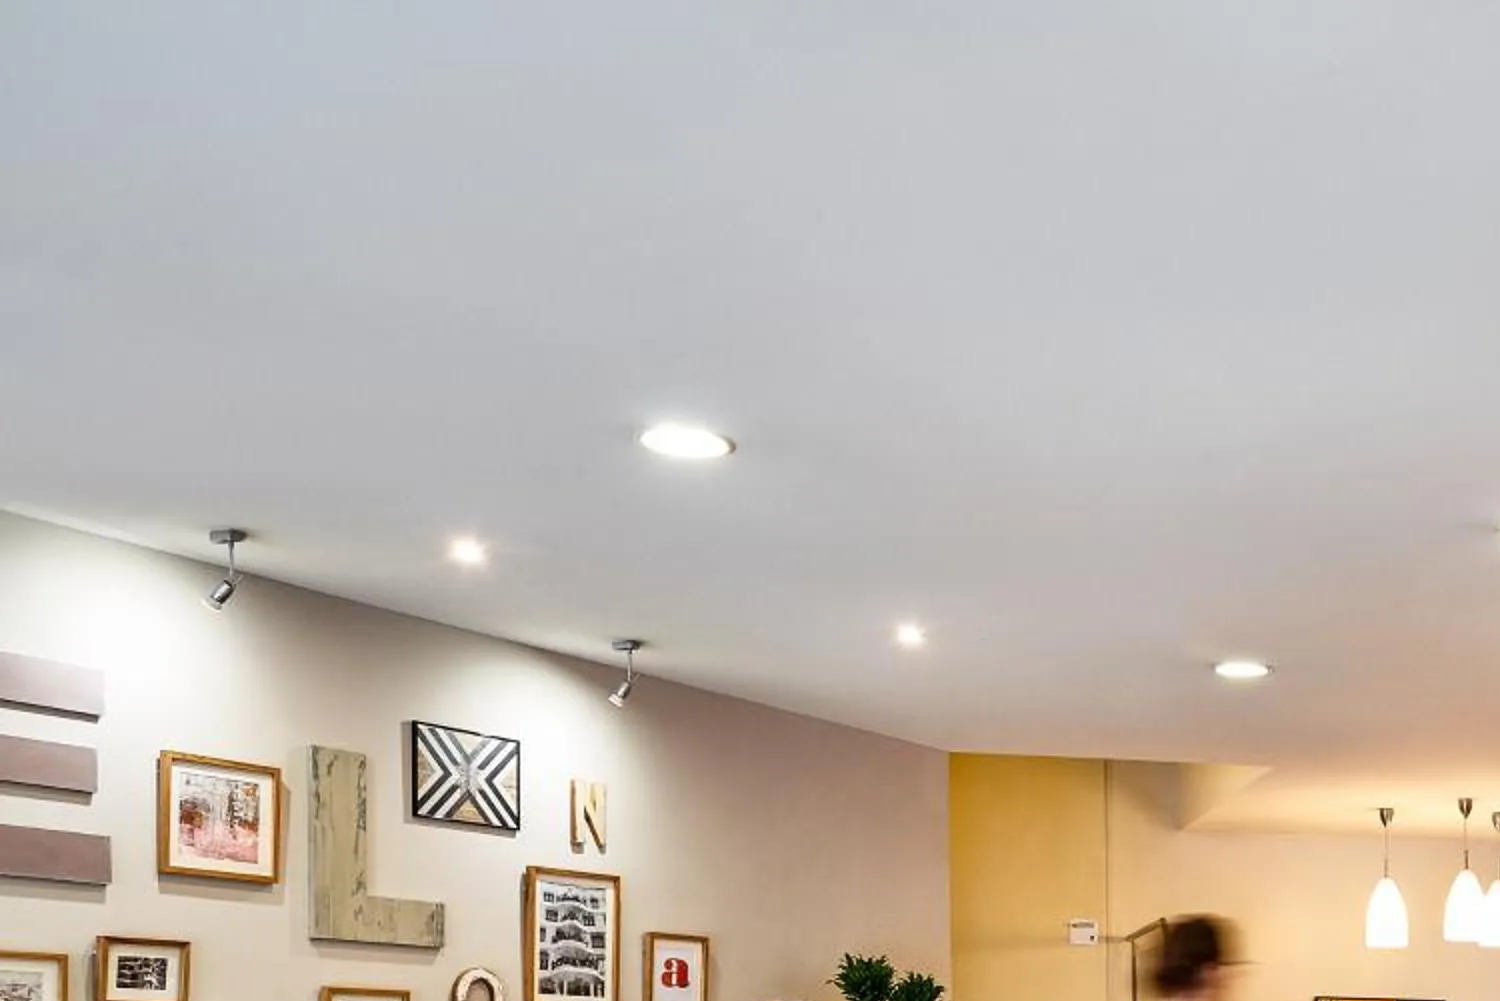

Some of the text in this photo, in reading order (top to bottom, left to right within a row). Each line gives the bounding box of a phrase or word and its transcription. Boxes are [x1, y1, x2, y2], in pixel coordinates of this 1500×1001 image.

[309, 745, 445, 949] L
[570, 778, 607, 850] N
[661, 957, 690, 988] a
